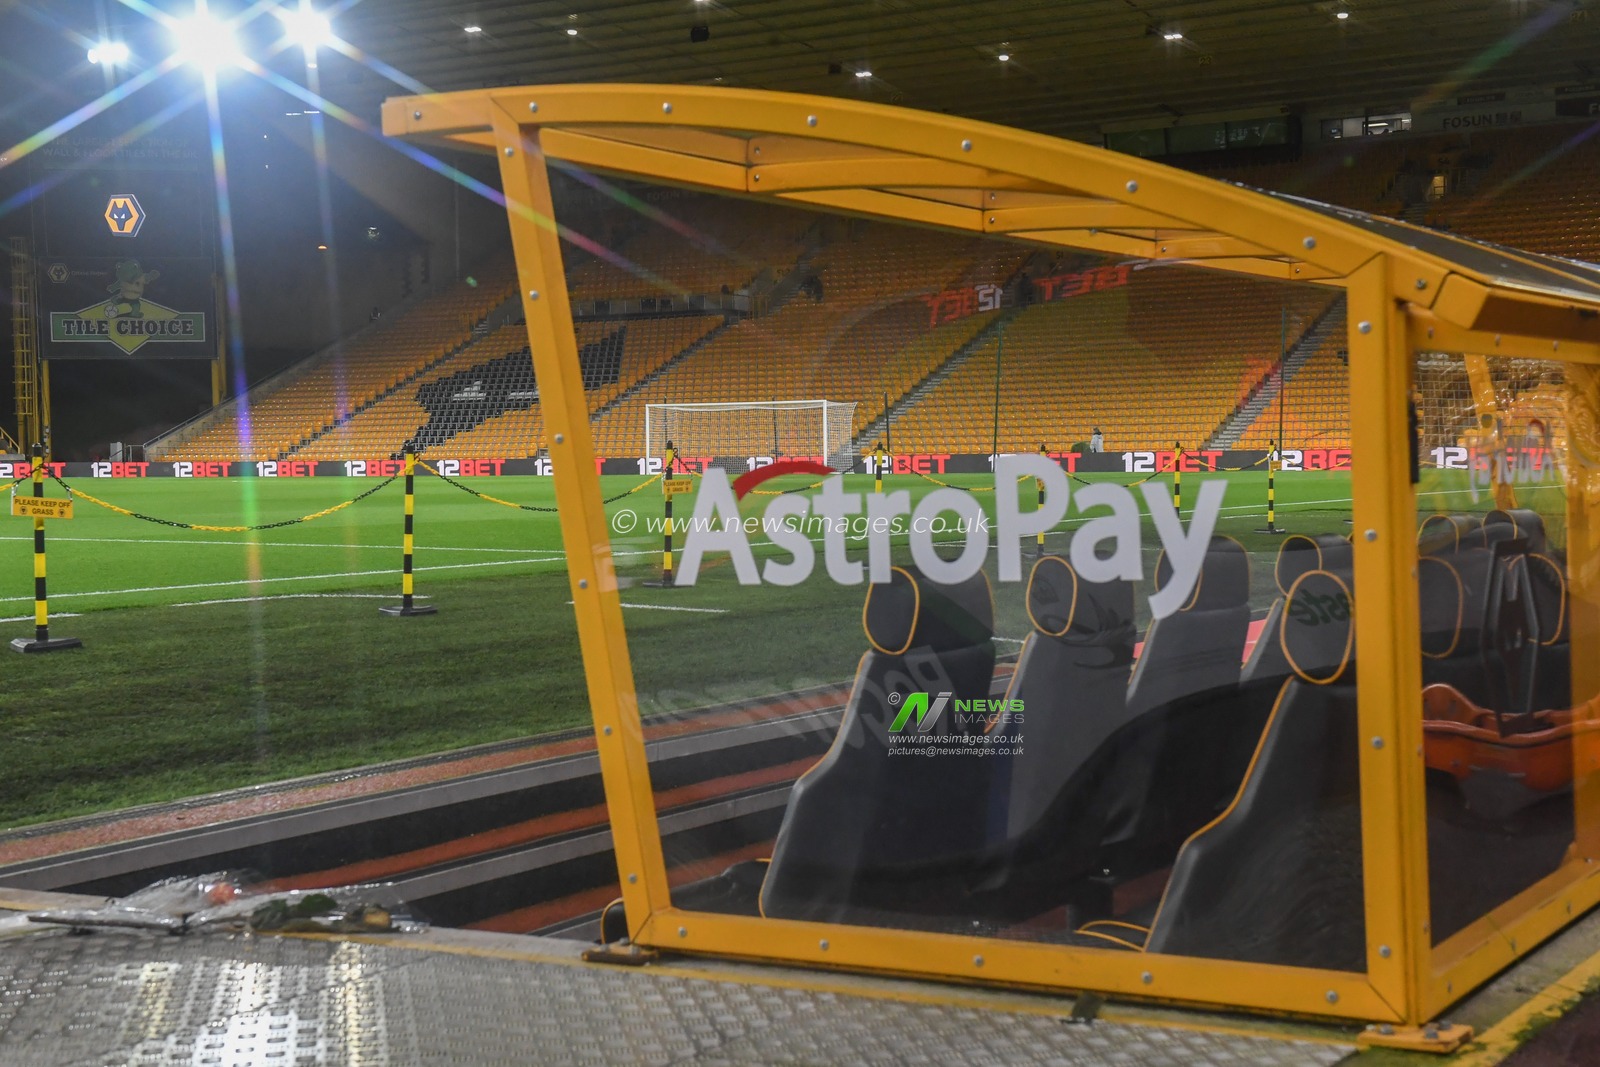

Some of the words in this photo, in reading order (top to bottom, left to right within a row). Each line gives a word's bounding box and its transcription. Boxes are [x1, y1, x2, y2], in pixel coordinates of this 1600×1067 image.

[1443, 114, 1492, 129] FOSUN
[62, 319, 109, 335] TILE
[116, 319, 193, 336] CHOICE
[91, 462, 149, 478] 12BET
[173, 461, 232, 478] 12BET
[256, 460, 318, 477] 12BET
[437, 459, 505, 476] 12BET
[863, 454, 950, 475] 12BET
[1122, 451, 1223, 473] 12BET
[14, 498, 39, 506] PLEASE
[40, 500, 57, 508] KEEP
[58, 501, 71, 509] OFF
[32, 507, 54, 516] GRASS
[674, 452, 1228, 620] AstroPay
